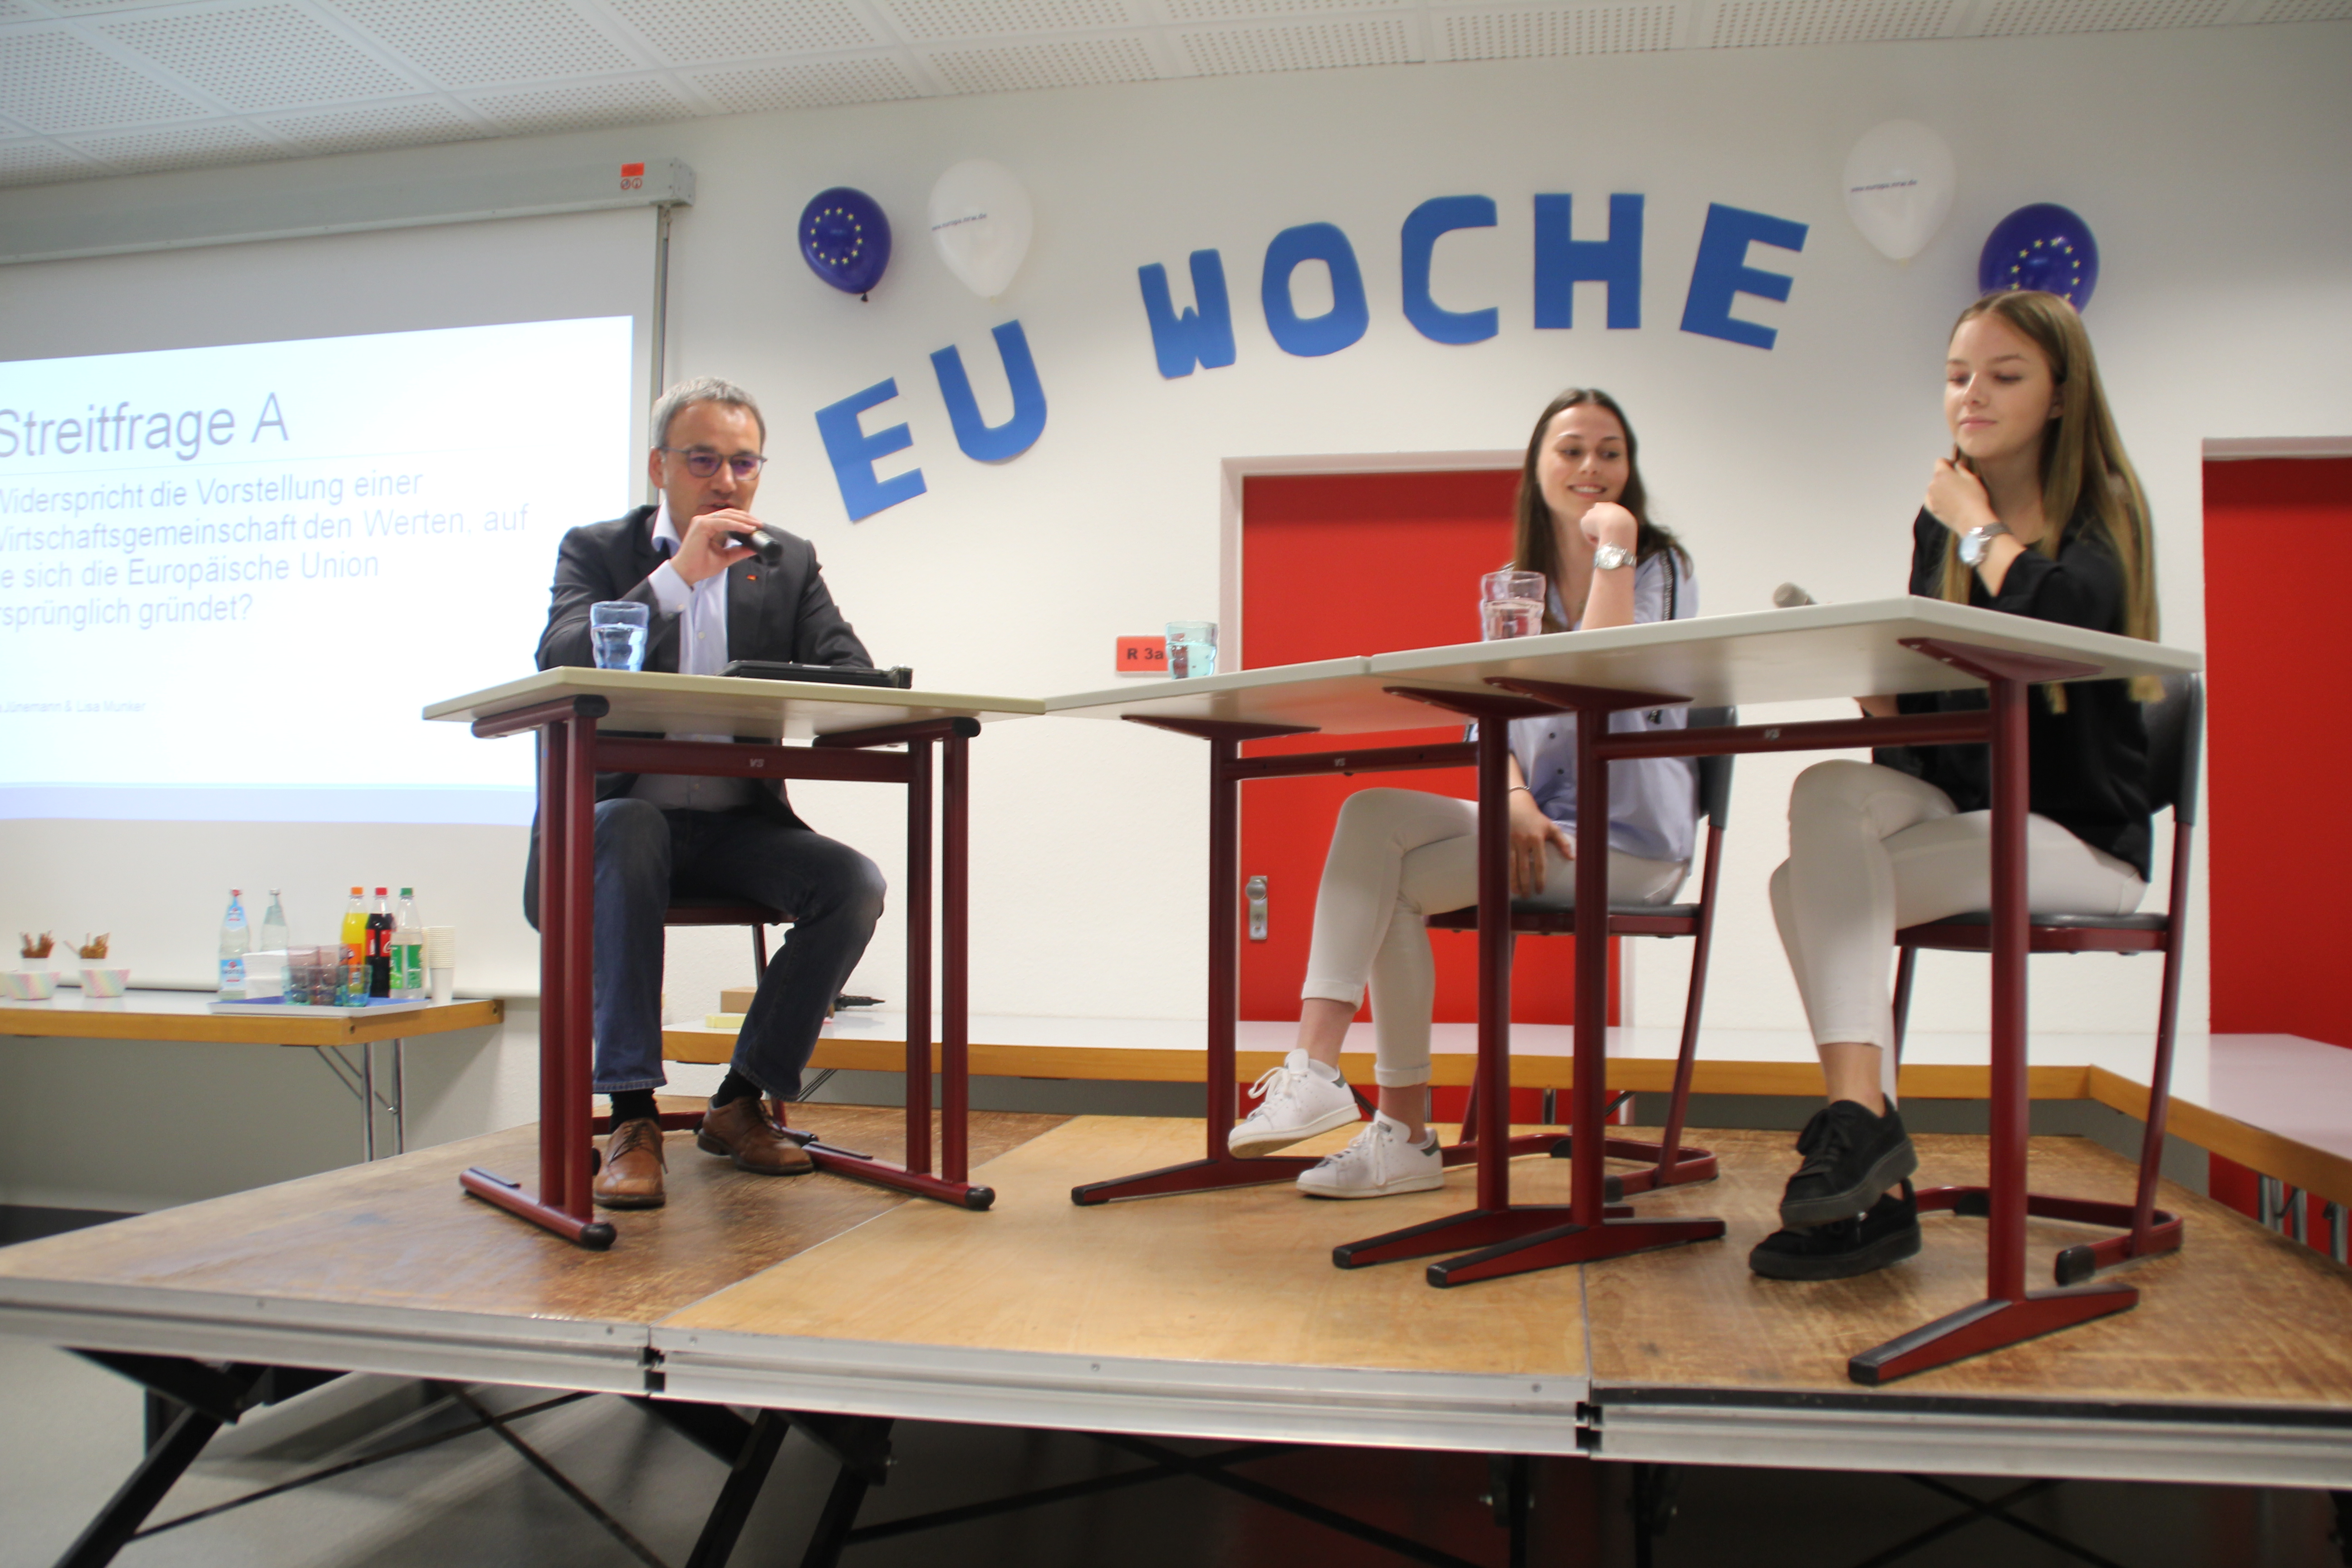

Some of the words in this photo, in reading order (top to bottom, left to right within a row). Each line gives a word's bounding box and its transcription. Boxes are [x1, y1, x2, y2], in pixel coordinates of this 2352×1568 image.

[815, 318, 1047, 523] EU
[1138, 193, 1809, 380] WOCHE
[0, 401, 235, 461] Streitfrage
[251, 392, 289, 443] A
[151, 480, 187, 507] die
[196, 474, 343, 505] Vorstellung
[355, 469, 424, 497] einer
[304, 512, 352, 539] den
[363, 509, 471, 537] Werten,
[483, 502, 530, 532] auf
[24, 561, 72, 588] sich
[81, 559, 118, 586] die
[128, 553, 289, 590] Europäische
[302, 550, 379, 579] Union
[0, 597, 130, 632] sprünglich
[138, 593, 253, 630] gründet?
[1127, 647, 1138, 660] R
[1144, 647, 1164, 660] 3a
